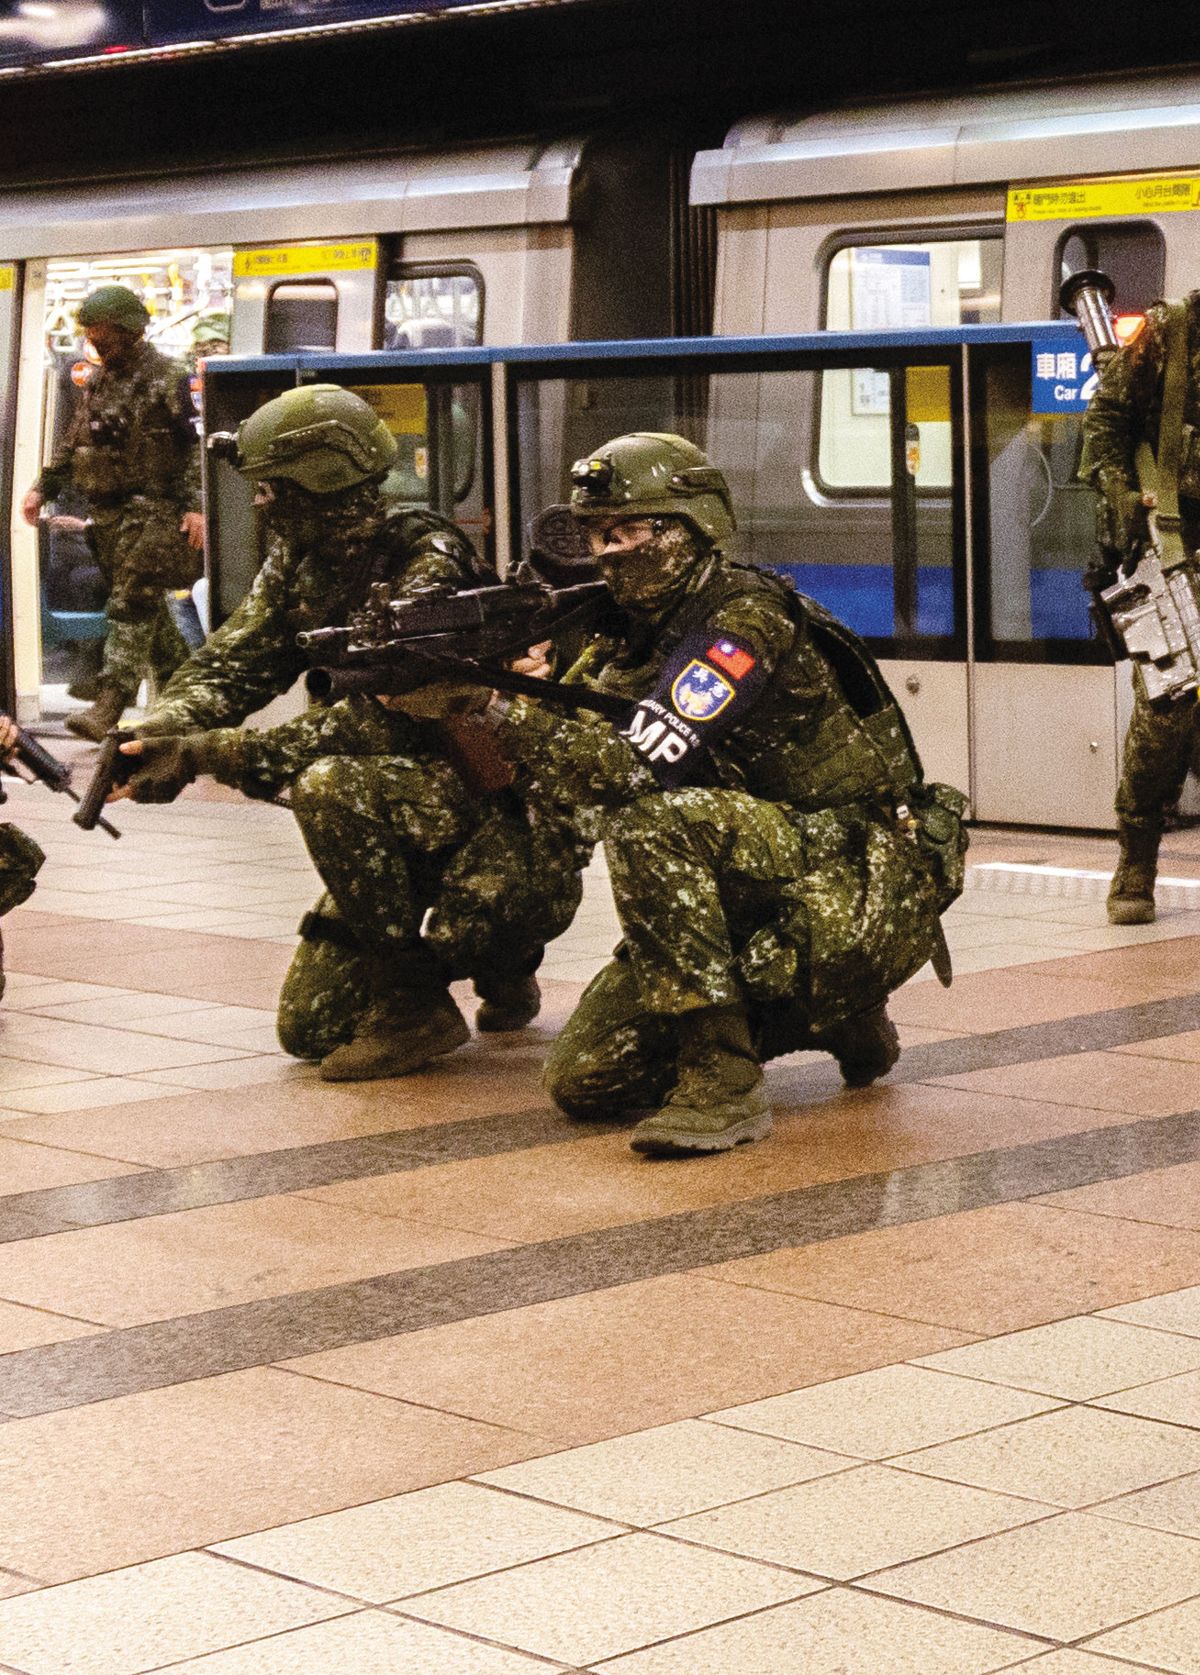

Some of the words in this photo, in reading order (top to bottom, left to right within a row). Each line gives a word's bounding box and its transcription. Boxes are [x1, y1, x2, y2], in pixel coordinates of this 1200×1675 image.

[1036, 352, 1077, 380] 車廂
[1054, 384, 1078, 401] Car
[619, 709, 688, 763] MP
[663, 711, 693, 737] POLICE
